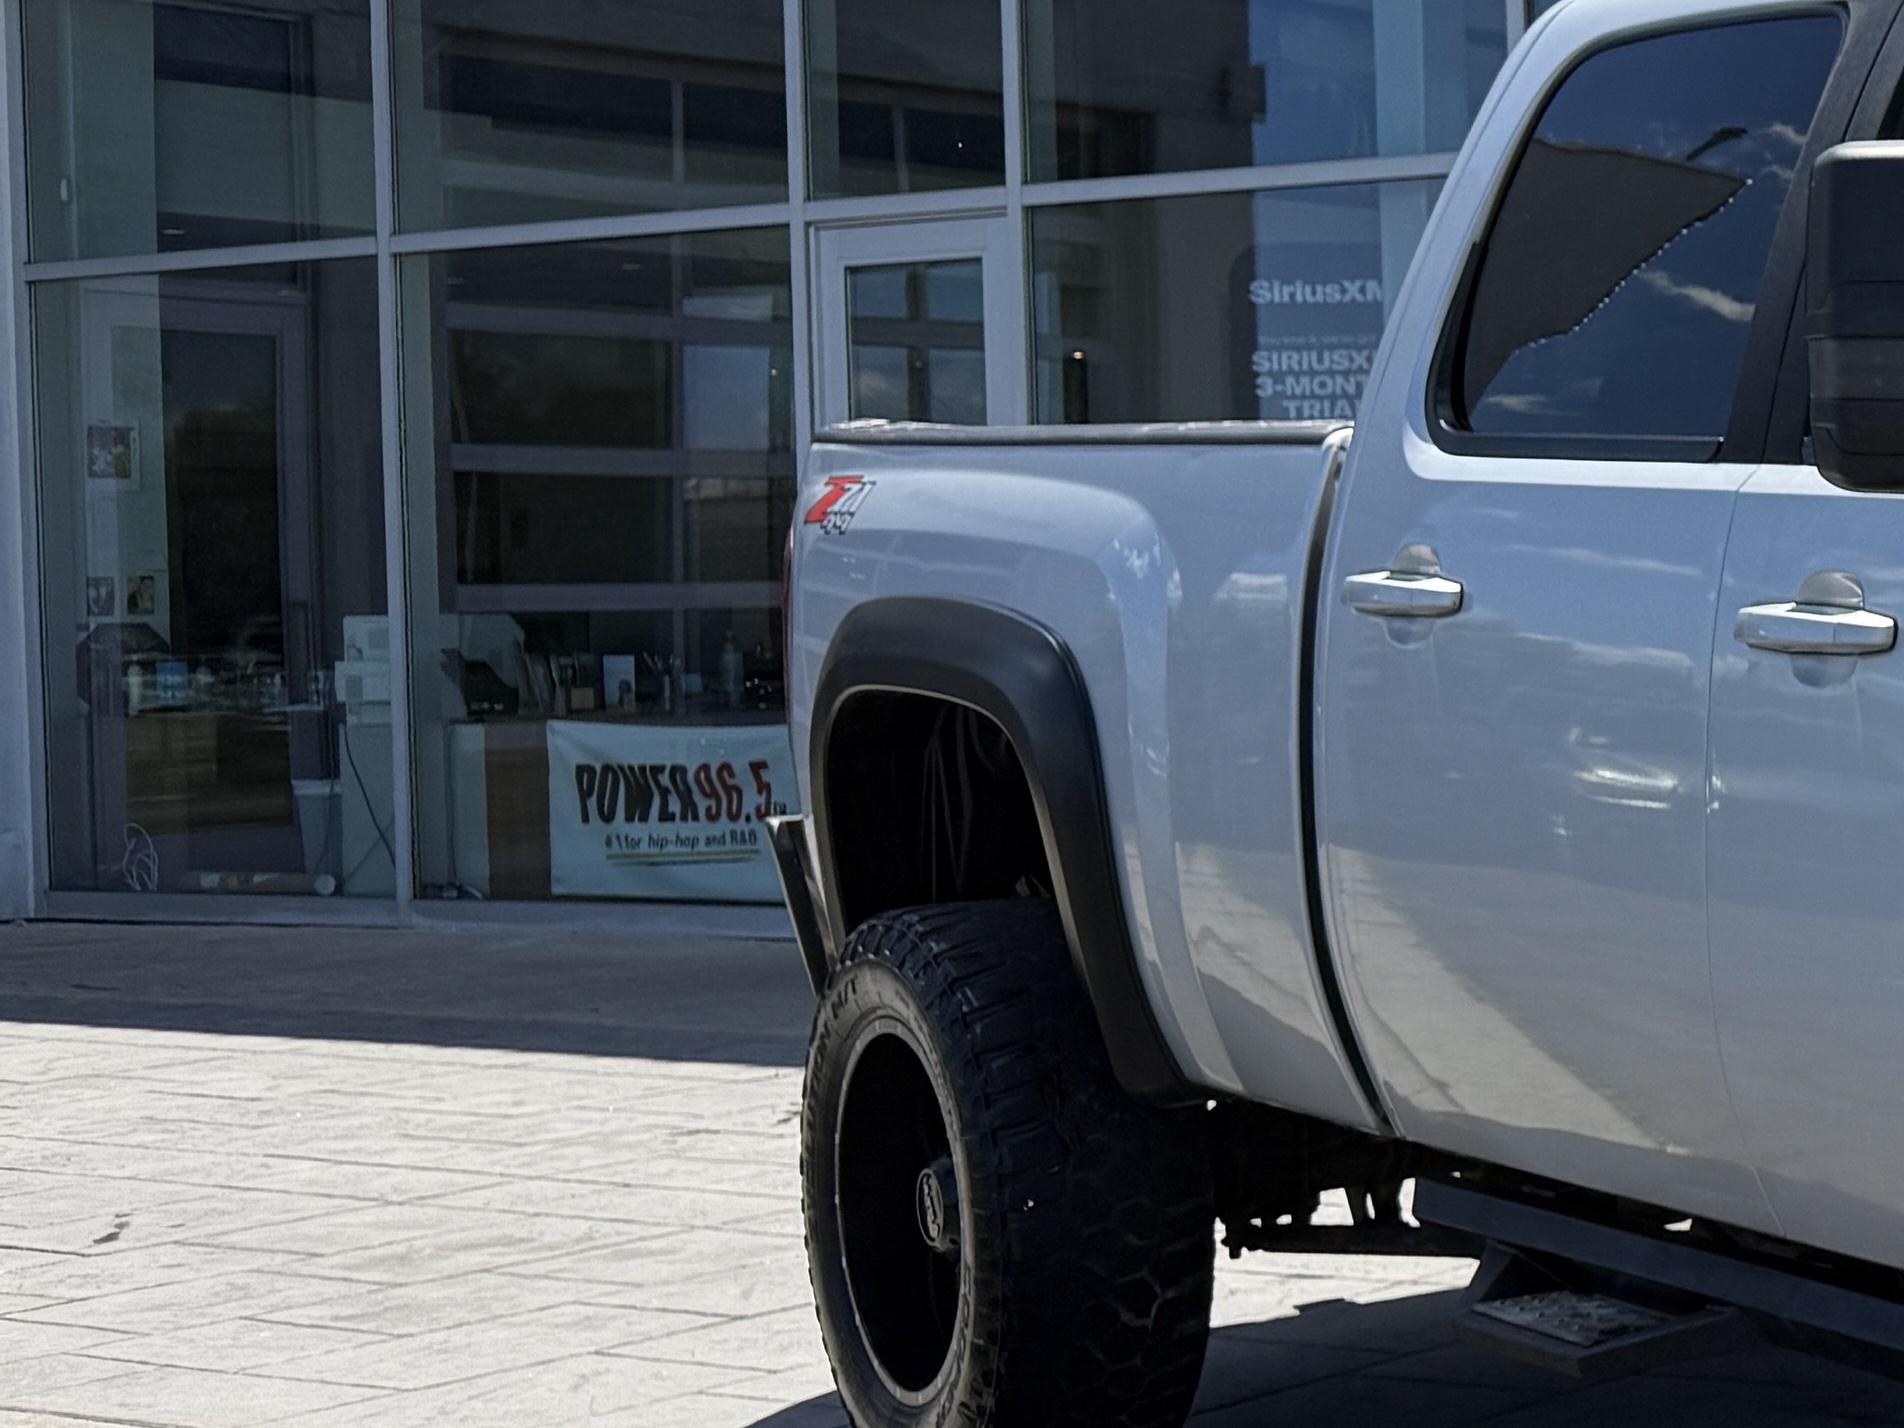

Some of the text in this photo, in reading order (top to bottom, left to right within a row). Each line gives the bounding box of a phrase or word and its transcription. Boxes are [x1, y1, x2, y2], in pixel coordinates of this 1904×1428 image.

[1252, 348, 1377, 373] SIRIUSX
[1255, 375, 1370, 398] 3-MONT
[1282, 399, 1362, 419] TRIA
[575, 763, 699, 823] POWER
[695, 759, 772, 823] 96.5
[624, 832, 642, 849] for
[648, 831, 699, 851] hip-hop
[704, 829, 727, 848] and
